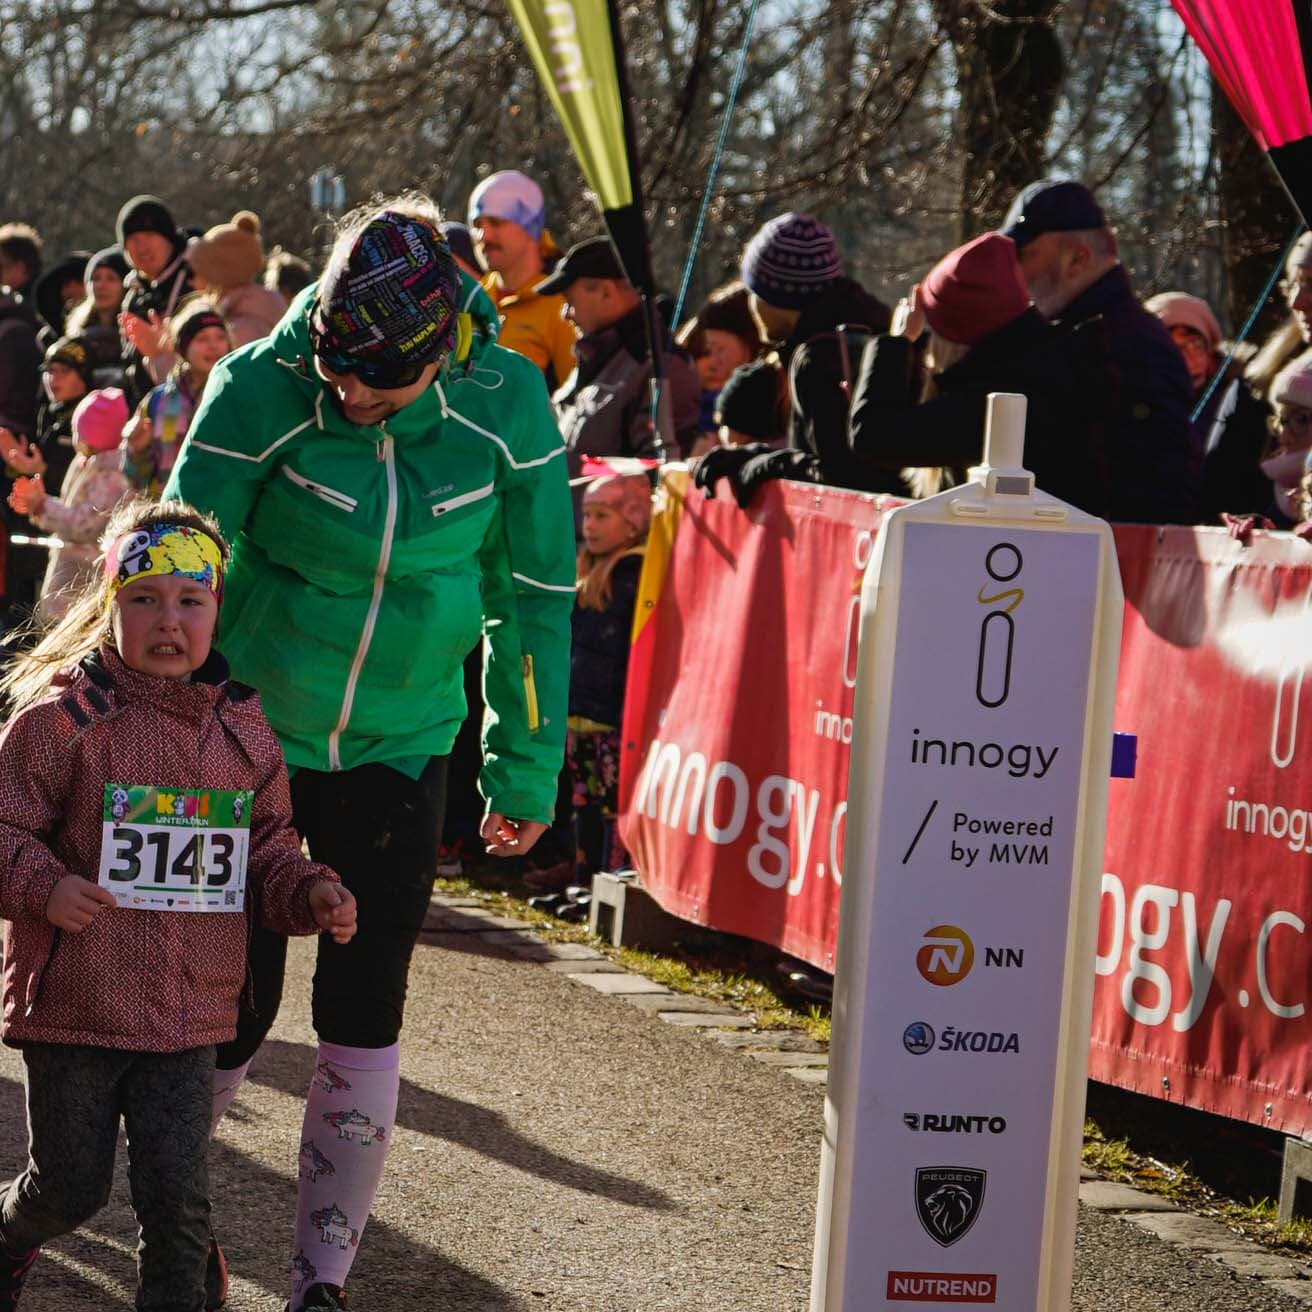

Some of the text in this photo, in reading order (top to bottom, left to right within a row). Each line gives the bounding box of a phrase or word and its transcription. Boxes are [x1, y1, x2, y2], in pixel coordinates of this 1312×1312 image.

[911, 729, 1059, 778] innogy
[953, 813, 1053, 838] Powered
[108, 828, 235, 886] 3143
[950, 840, 1049, 867] by MVM
[984, 947, 1024, 969] NN
[939, 1026, 1020, 1054] ŠKODA
[923, 1114, 1007, 1134] RUNTO
[921, 1173, 981, 1182] PEUGEOT
[893, 1278, 991, 1296] NUTREND
